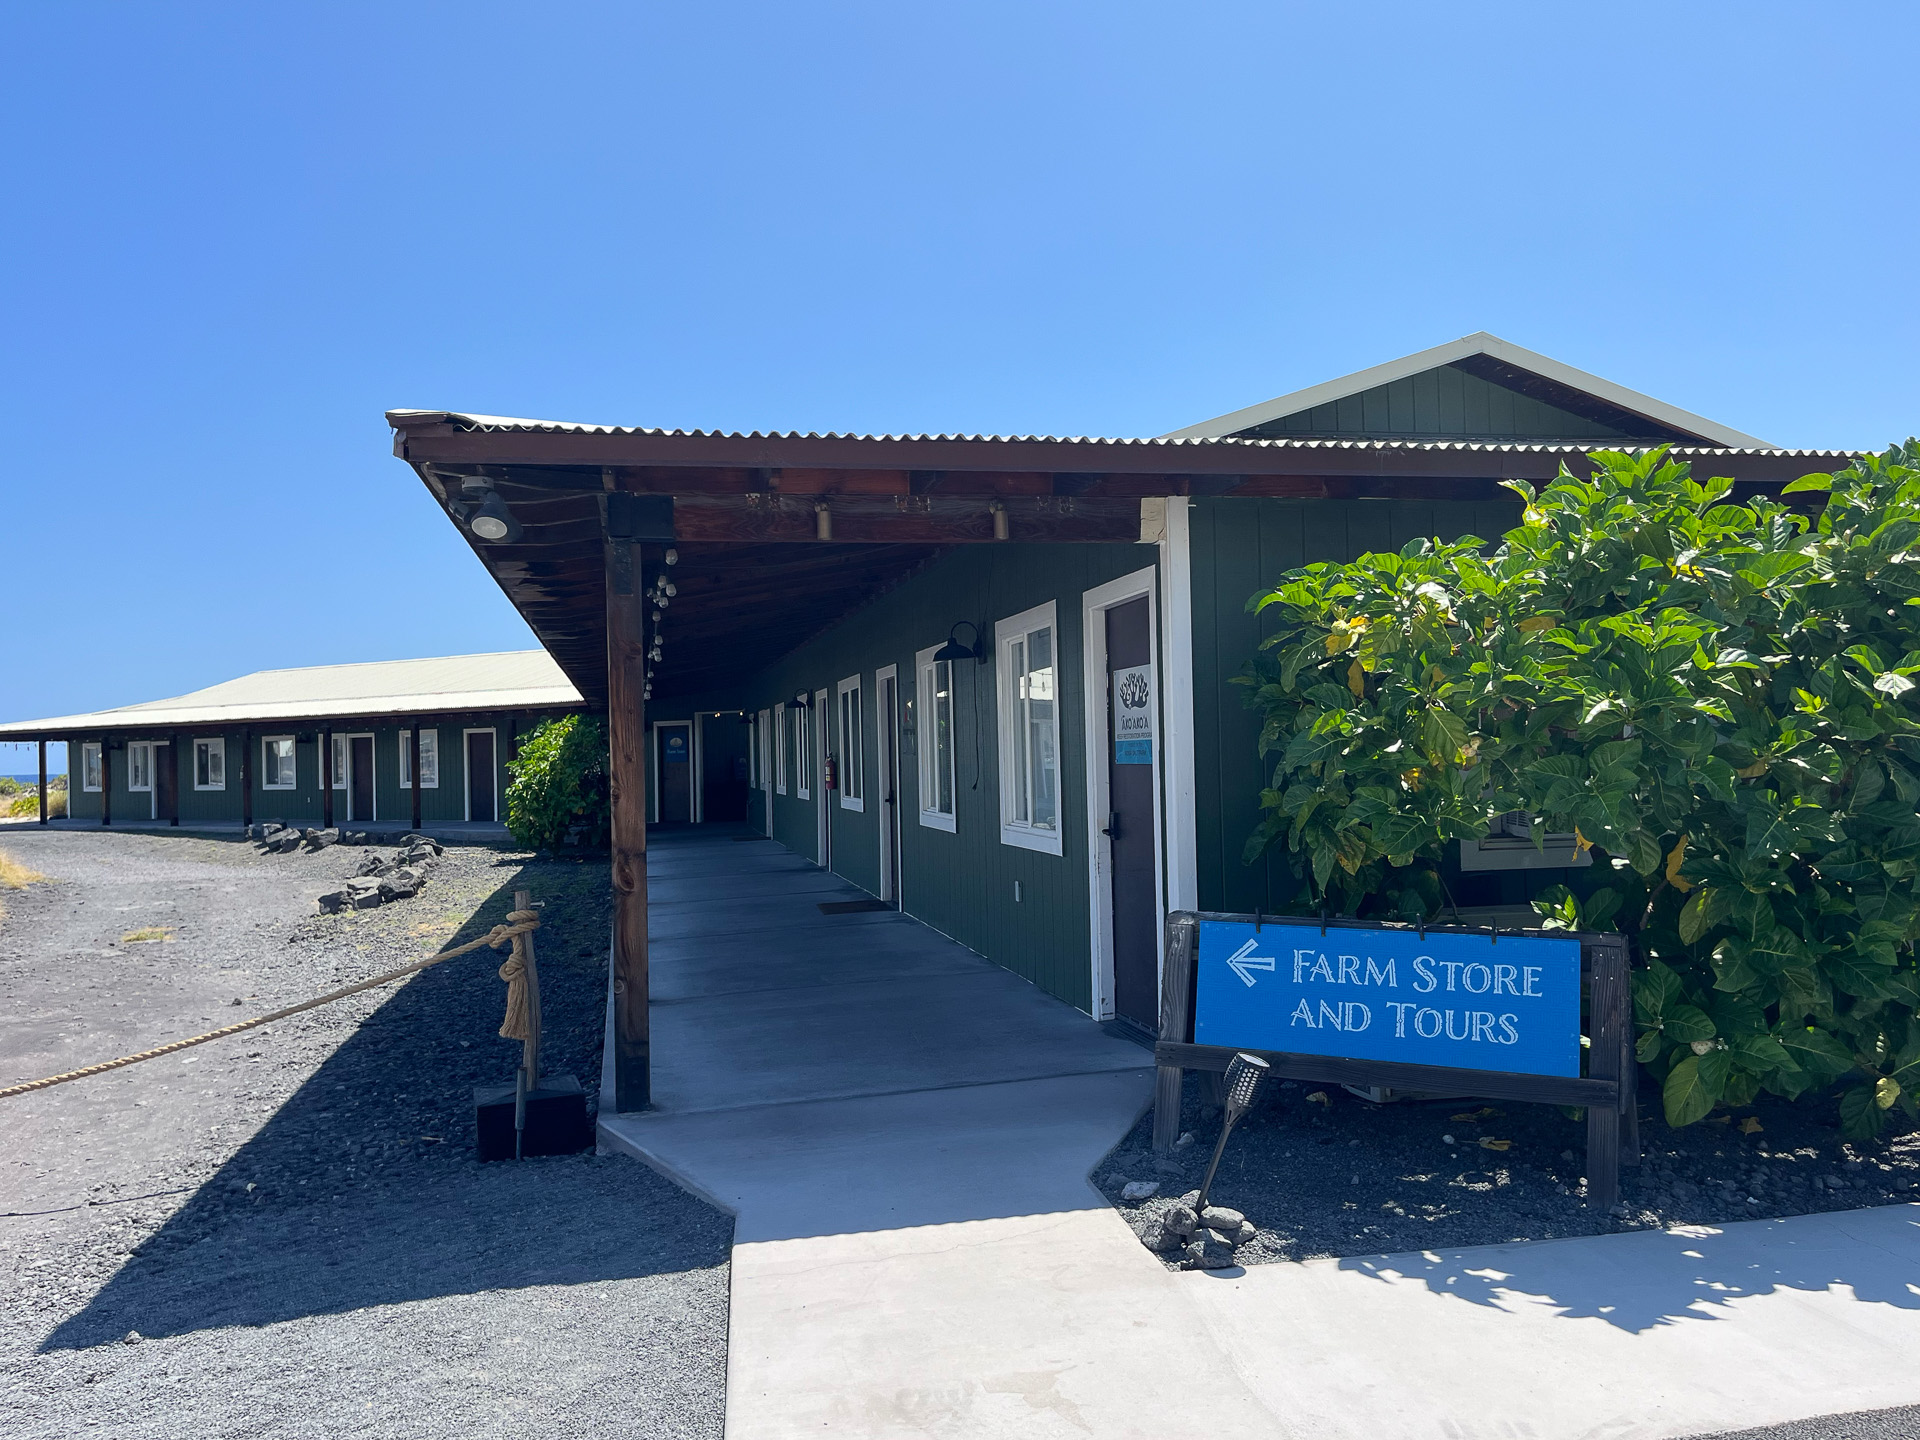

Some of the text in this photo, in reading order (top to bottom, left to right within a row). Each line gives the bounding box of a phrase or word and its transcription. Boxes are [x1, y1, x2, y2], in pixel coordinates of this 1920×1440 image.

[1292, 949, 1543, 998] FARM STORE
[1290, 997, 1519, 1045] AND TOURS
